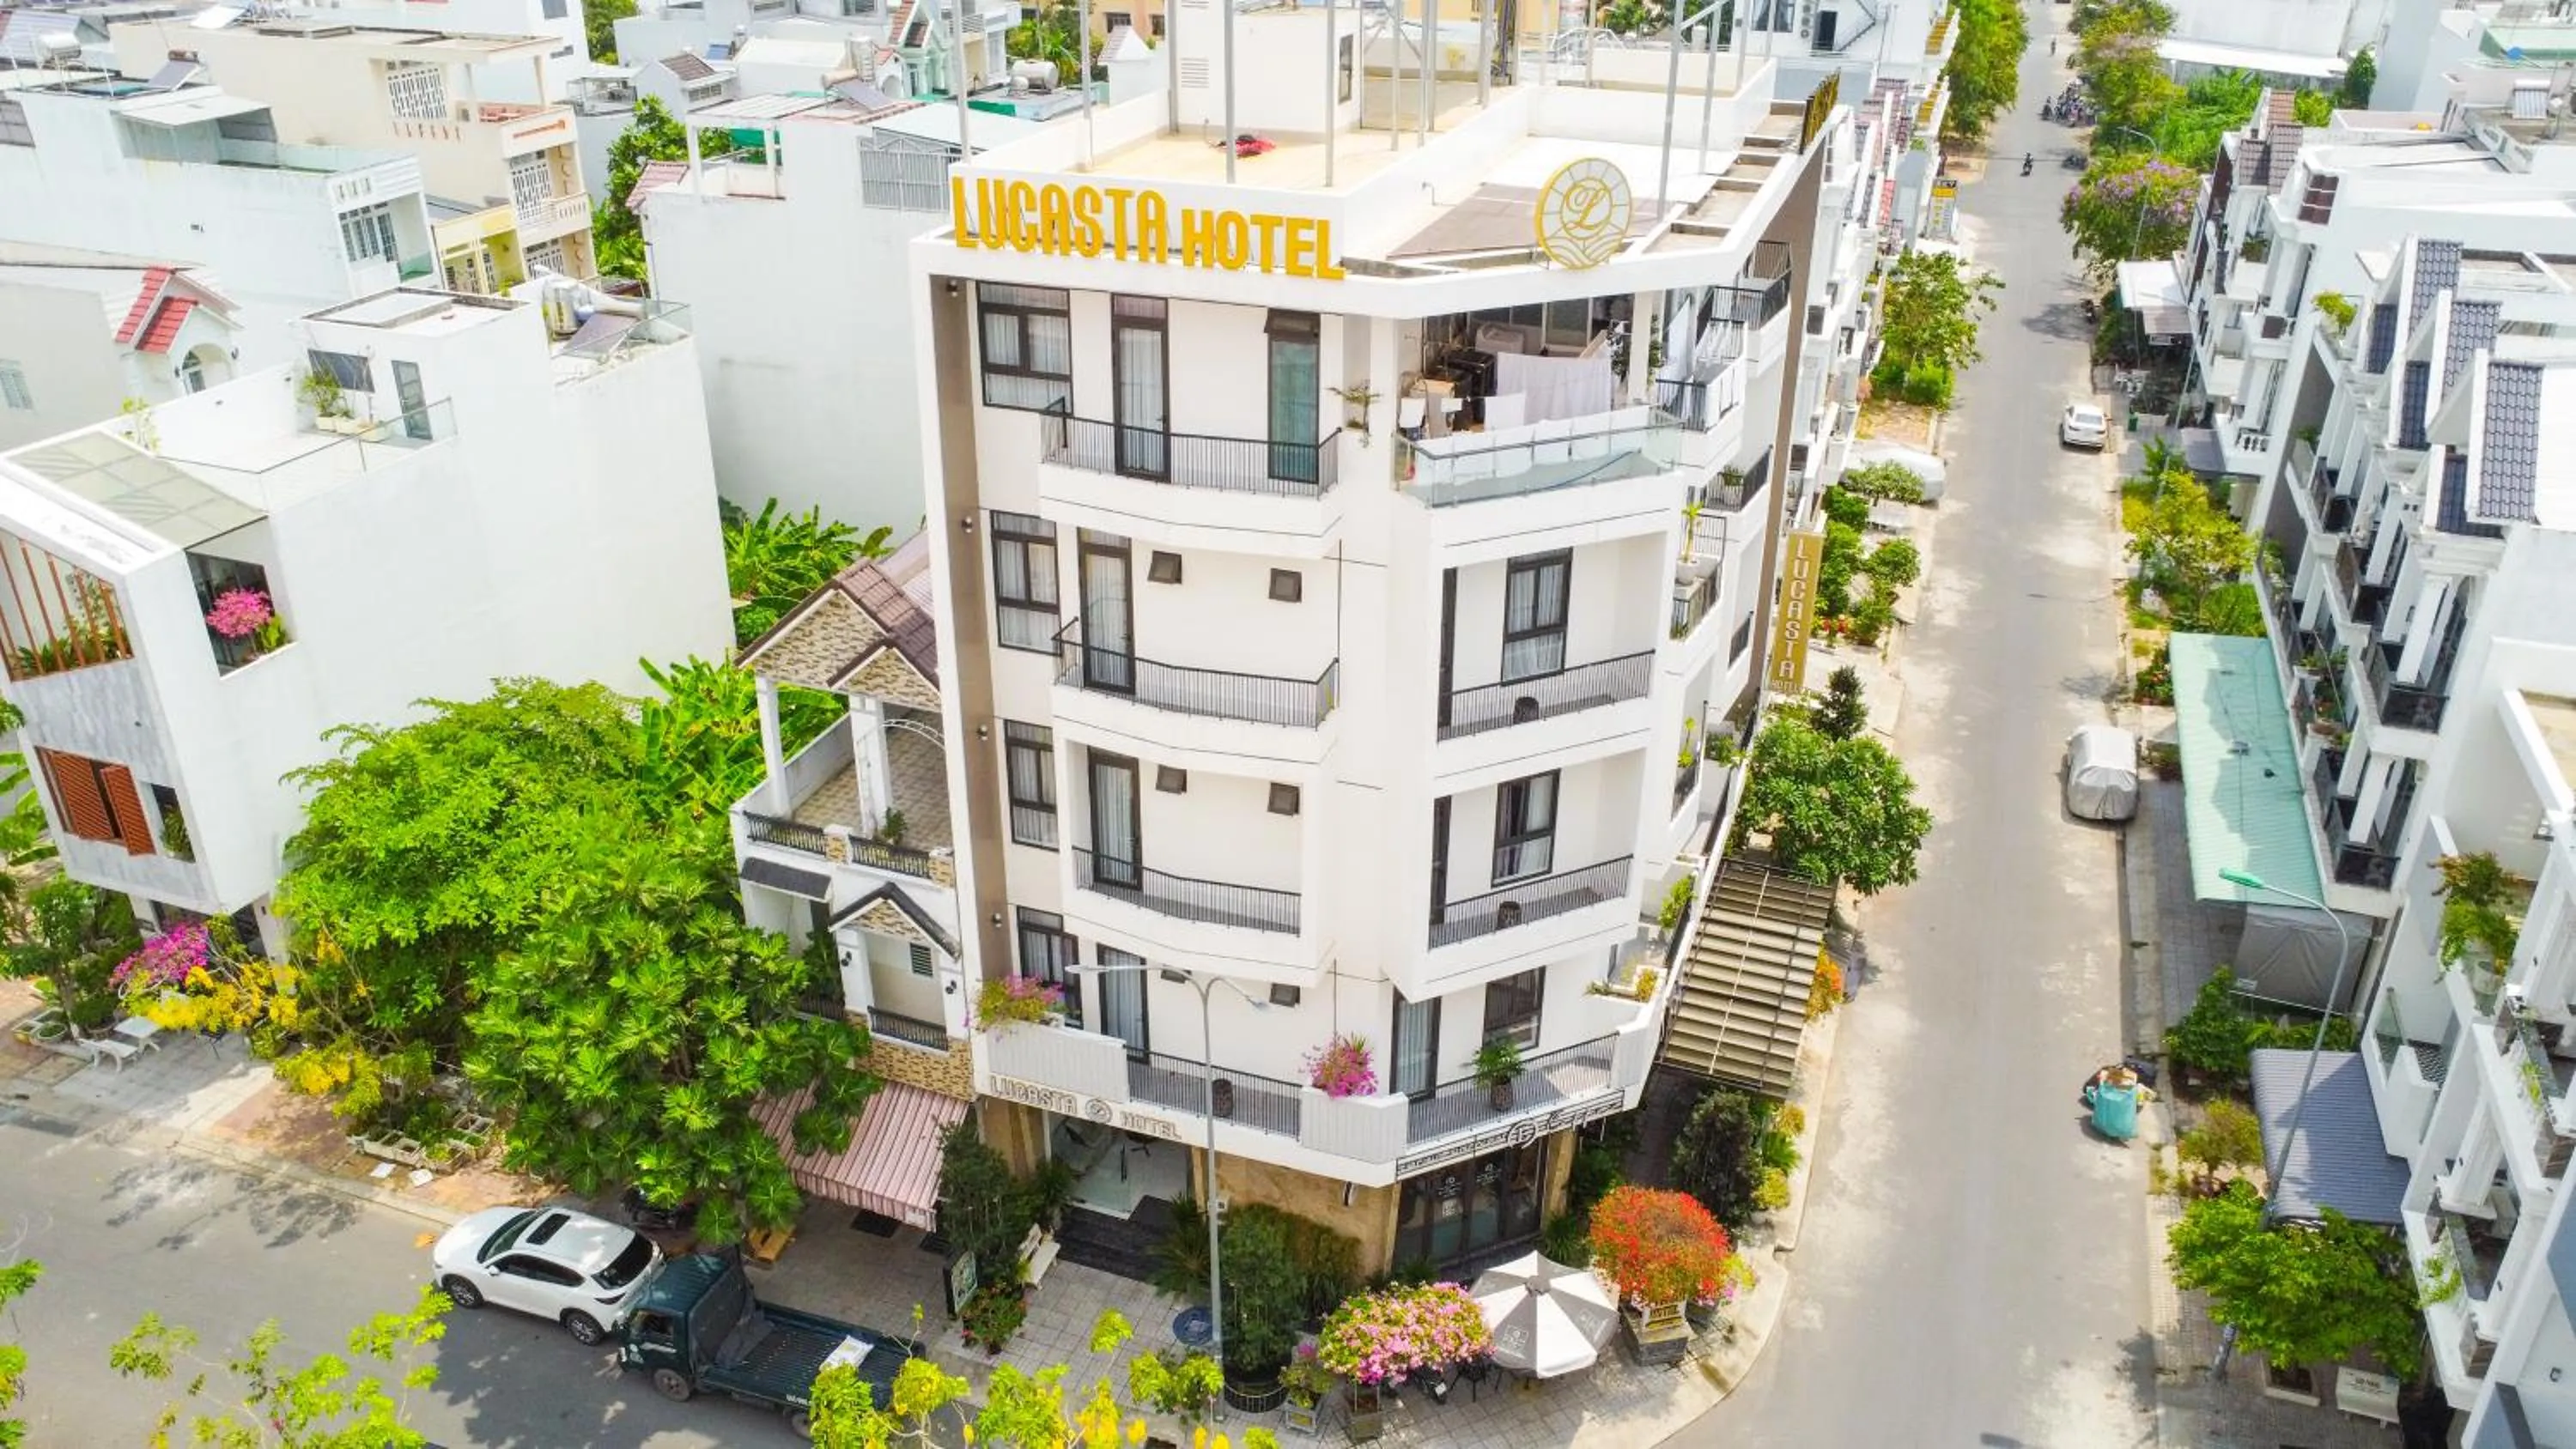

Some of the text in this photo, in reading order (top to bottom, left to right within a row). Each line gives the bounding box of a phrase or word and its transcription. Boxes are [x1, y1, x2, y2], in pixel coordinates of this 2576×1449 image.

[952, 176, 1346, 280] LUCASTA HOTEL
[1778, 538, 1809, 679] LUCASTA
[990, 1075, 1182, 1140] LUCASTA HOTEL
